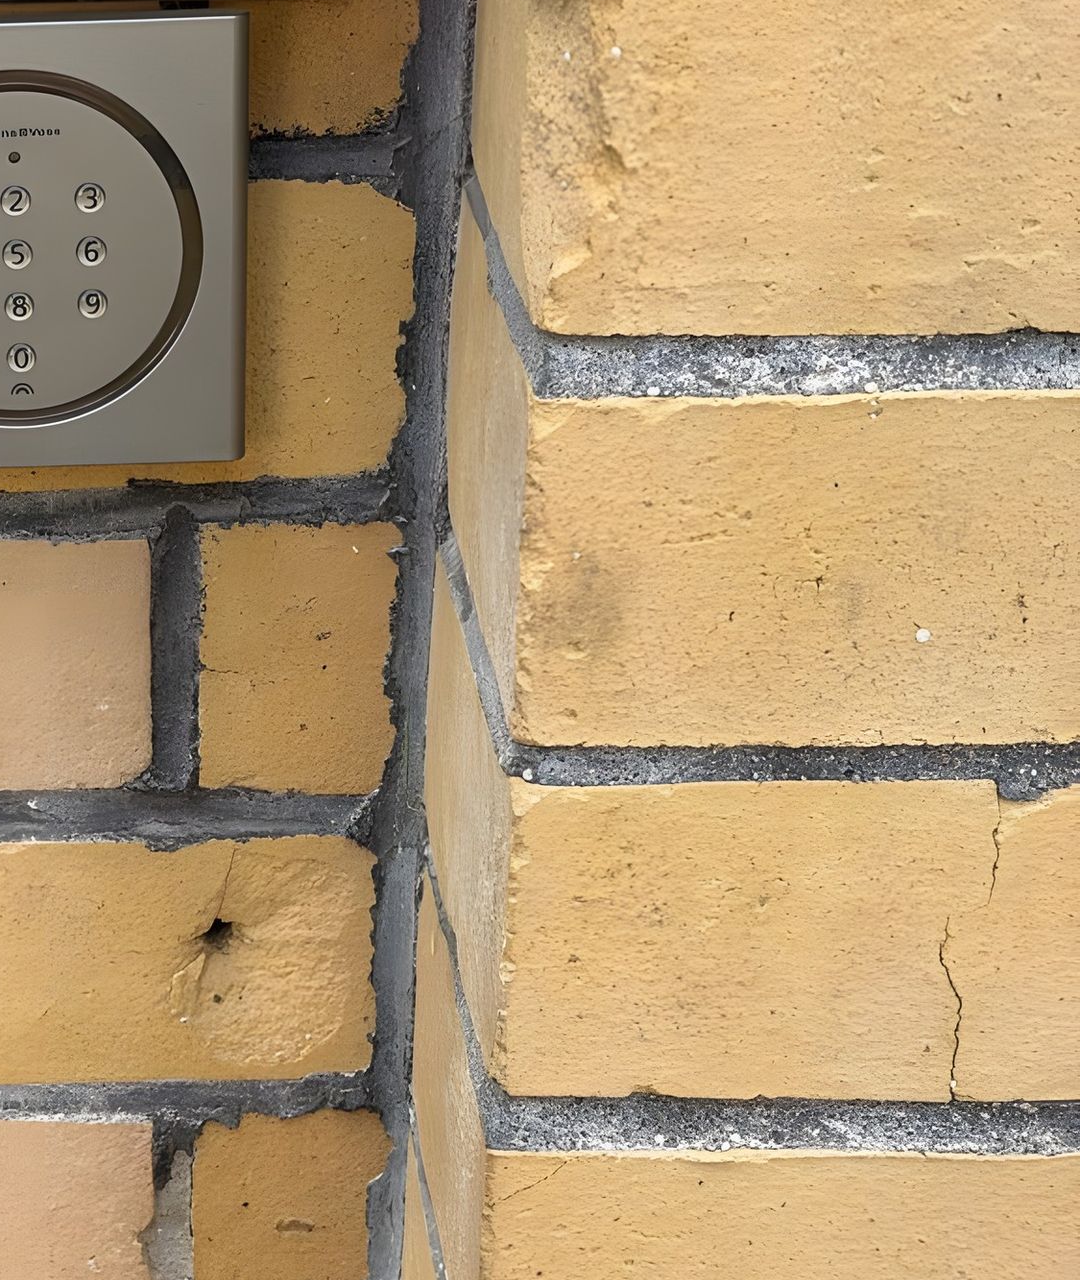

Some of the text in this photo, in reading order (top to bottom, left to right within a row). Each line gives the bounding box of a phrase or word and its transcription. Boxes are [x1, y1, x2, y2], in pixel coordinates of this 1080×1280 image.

[8, 189, 24, 212] 2
[81, 186, 98, 210] 3
[9, 243, 26, 265] 5
[83, 240, 99, 263] 6
[11, 295, 28, 318] 8
[85, 293, 101, 315] 9
[13, 346, 30, 369] 0
